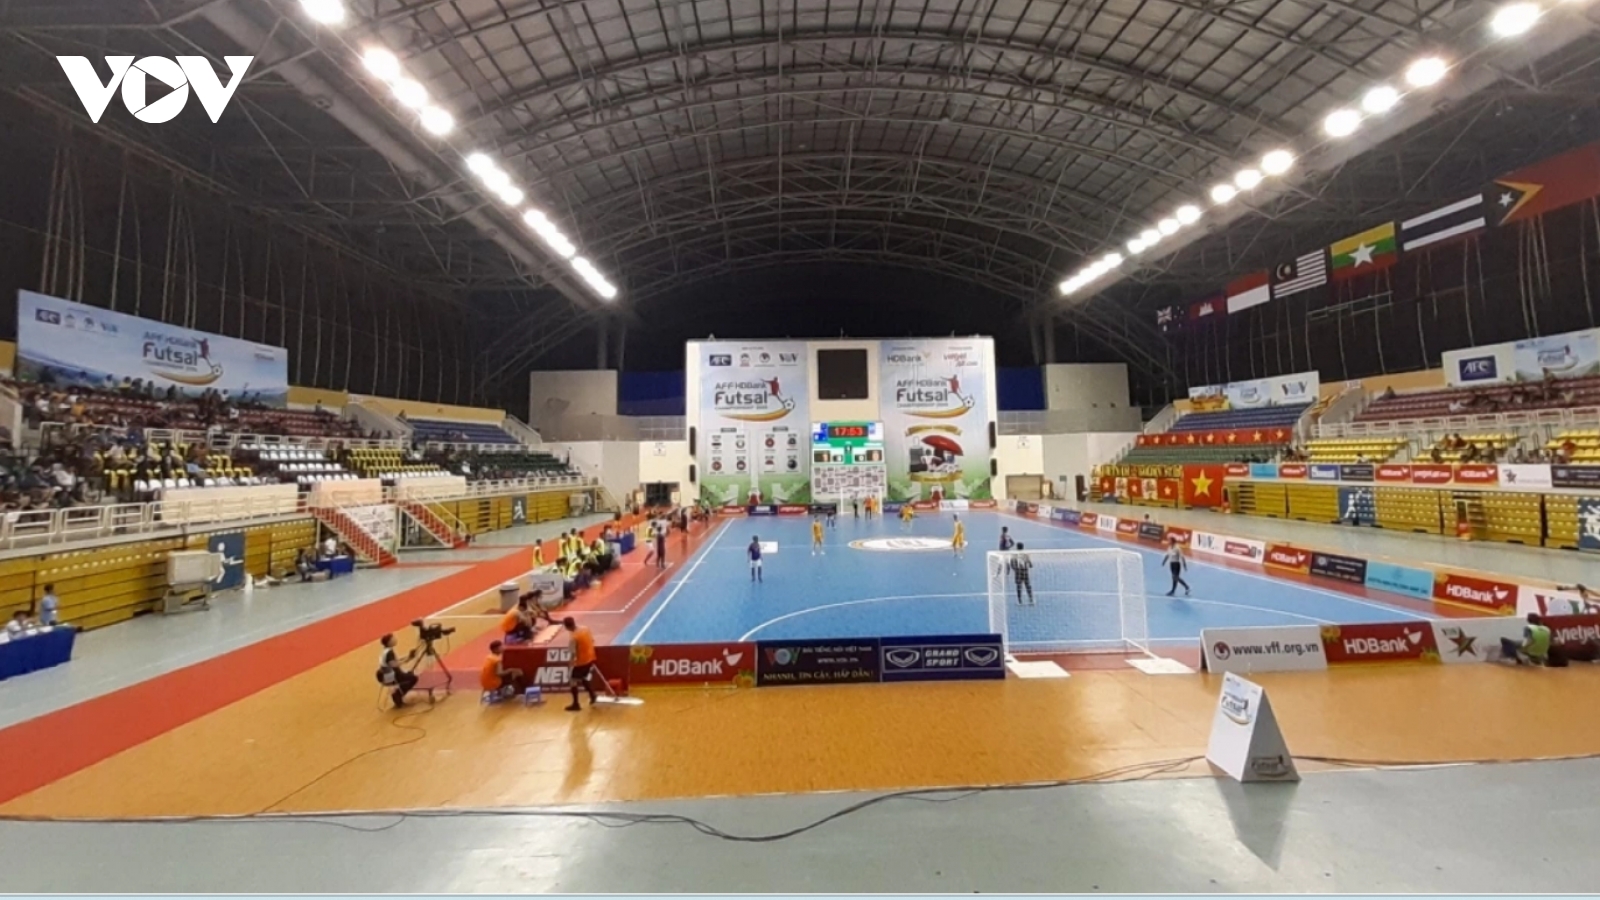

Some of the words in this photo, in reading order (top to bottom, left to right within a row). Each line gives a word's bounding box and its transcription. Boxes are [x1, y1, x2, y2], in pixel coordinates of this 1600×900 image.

[142, 342, 198, 366] Futsal
[886, 354, 922, 363] HDBank
[1463, 361, 1489, 374] AFC
[714, 381, 735, 390] AFF
[735, 381, 767, 390] HDBank
[916, 379, 948, 387] HDBank
[714, 391, 769, 405] Futsal
[896, 388, 949, 402] Futsal
[1446, 584, 1494, 603] HDBank
[1232, 641, 1320, 657] www.vff.org.vn
[1343, 636, 1410, 654] HDBank
[763, 646, 802, 666] VOV
[925, 649, 960, 657] GRAND
[652, 658, 723, 677] HDBank
[926, 658, 960, 667] SPORT
